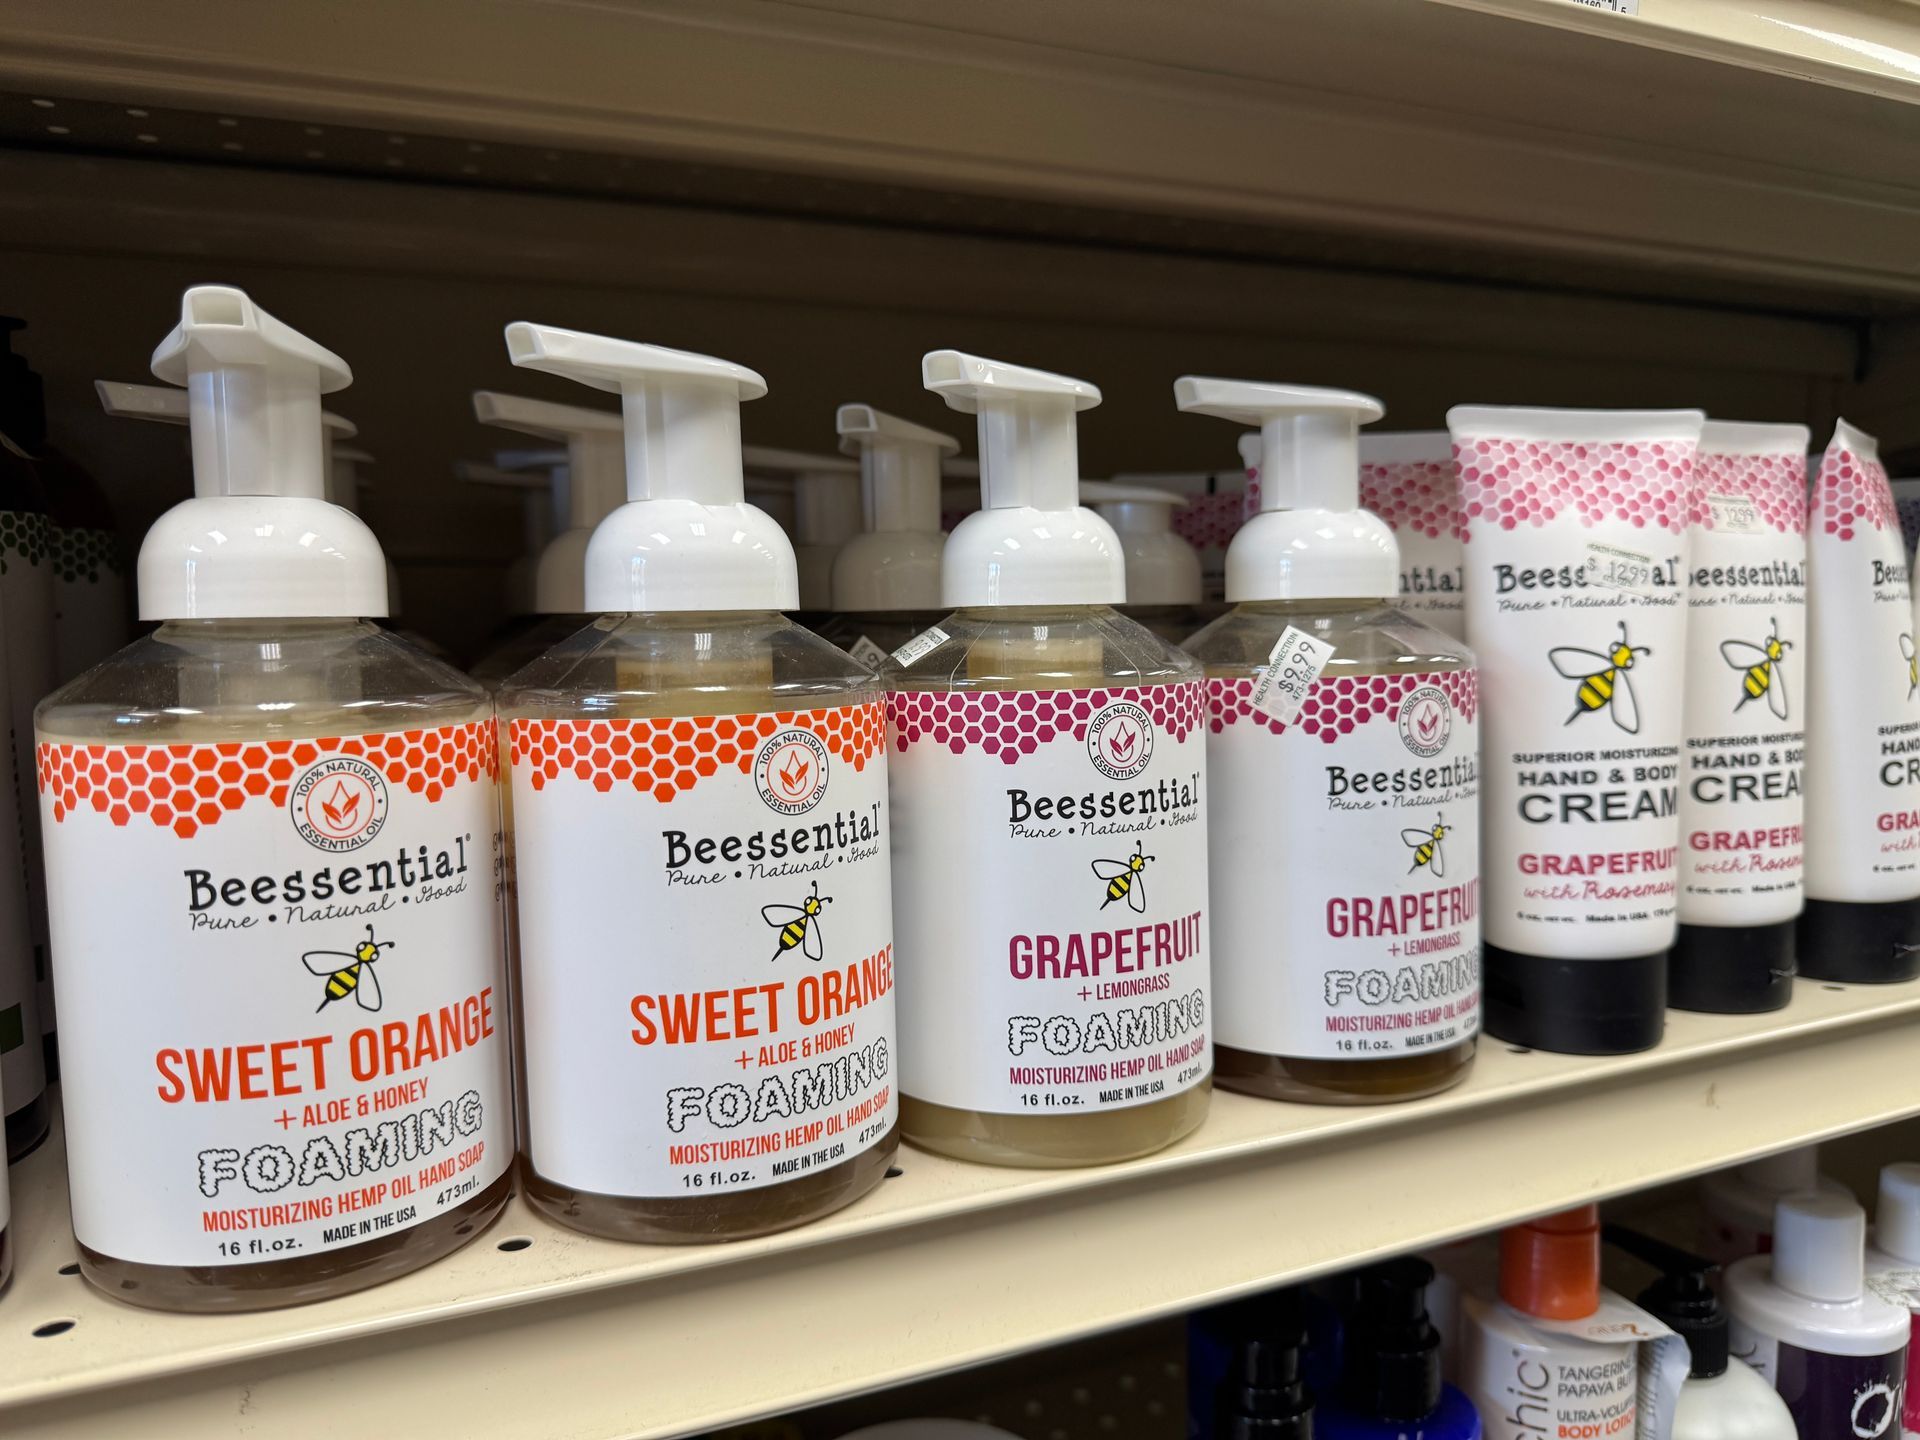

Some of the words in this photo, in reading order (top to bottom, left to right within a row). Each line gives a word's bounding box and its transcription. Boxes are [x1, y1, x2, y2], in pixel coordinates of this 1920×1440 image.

[1254, 672, 1273, 706] HEALTH
[1267, 631, 1299, 680] CONNECTION
[1278, 641, 1317, 693] $9.99
[1292, 664, 1317, 702] 473-1275
[1420, 690, 1448, 711] NATURAL
[1092, 711, 1112, 734] 100%
[1113, 706, 1149, 732] NATURAL
[759, 740, 782, 765] 100%
[783, 733, 824, 761] NATURAL
[1403, 734, 1440, 755] ESSENTIAL
[1440, 732, 1450, 748] OIL
[1512, 752, 1595, 764] SUPERIOR
[1686, 736, 1759, 748] SUPERIOR
[1093, 754, 1139, 778] ESSENTIAL
[1138, 753, 1150, 768] OIL
[1518, 770, 1598, 786] HAND
[1608, 768, 1624, 784] &
[1633, 764, 1677, 782] BODY
[1691, 753, 1761, 769] HAND
[1767, 751, 1780, 765] &
[297, 769, 324, 797] 100%
[326, 761, 381, 791] NATURAL
[761, 788, 814, 813] ESSENTIAL
[812, 783, 826, 801] OIL
[1328, 797, 1375, 811] Pure
[1391, 790, 1453, 808] Natural
[1518, 785, 1677, 824] CREAM
[300, 822, 367, 850] ESSENTIAL
[366, 816, 383, 836] OIL
[1009, 824, 1062, 839] Pure
[1080, 812, 1157, 836] Natural
[666, 869, 726, 887] Pure
[747, 854, 834, 880] Natural
[190, 912, 259, 931] Pure
[284, 894, 396, 925] Natural
[415, 877, 467, 905] Good
[1009, 911, 1202, 980] GRAPEFRUIT
[1404, 931, 1461, 956] LEMONGRASS
[630, 981, 785, 1046] SWEET
[797, 943, 893, 1026] ORANGE
[1096, 973, 1170, 1000] LEMONGRASS
[1008, 988, 1205, 1056] FOAMING
[1326, 1012, 1412, 1032] MOISTURIZING
[1414, 1006, 1442, 1026] HEMP
[1443, 1003, 1455, 1019] OIL
[155, 1034, 333, 1105] SWEET
[349, 987, 495, 1083] ORANGE
[758, 1039, 797, 1068] ALOE
[801, 1036, 812, 1057] &
[815, 1022, 855, 1053] HONEY
[1337, 1040, 1351, 1050] 16
[1405, 1034, 1425, 1047] MADE
[1426, 1033, 1433, 1043] IN
[1434, 1030, 1444, 1042] THE
[1445, 1027, 1455, 1037] USA
[1009, 1064, 1107, 1085] MOISTURIZING
[1110, 1056, 1145, 1080] HEMP
[1147, 1051, 1164, 1072] OIL
[1166, 1043, 1189, 1069] HAND
[1190, 1033, 1205, 1060] SOAP
[666, 1036, 889, 1133] FOAMING
[1021, 1094, 1038, 1106] 16
[1045, 1093, 1084, 1106] fl.oz.
[1099, 1089, 1123, 1103] MADE
[1125, 1087, 1133, 1100] IN
[1134, 1083, 1149, 1098] THE
[1150, 1079, 1164, 1095] USA
[302, 1098, 351, 1128] ALOE
[357, 1093, 369, 1117] &
[373, 1077, 429, 1111] HONEY
[669, 1132, 781, 1166] MOISTURIZING
[785, 1119, 824, 1148] HEMP
[826, 1110, 845, 1136] OIL
[847, 1097, 873, 1129] HAND
[872, 1083, 890, 1113] SOAP
[198, 1089, 484, 1198] FOAMING
[683, 1173, 703, 1188] 16
[710, 1171, 756, 1186] fl.oz.
[772, 1160, 799, 1177] MADE
[801, 1156, 811, 1169] IN
[811, 1148, 829, 1167] THE
[829, 1142, 845, 1161] USA
[858, 1119, 887, 1144] 473ml.
[202, 1196, 333, 1233] MOISTURIZING
[338, 1182, 388, 1214] HEMP
[391, 1171, 417, 1200] OIL
[419, 1156, 457, 1191] HAND
[457, 1140, 485, 1173] SOAP
[218, 1240, 241, 1257] 16
[249, 1236, 303, 1255] fl.oz.
[323, 1225, 358, 1244] MADE
[359, 1222, 372, 1237] IN
[373, 1215, 396, 1235] THE
[396, 1205, 417, 1225] USA
[436, 1174, 481, 1207] 473ml.
[1557, 1381, 1614, 1397] PAPAYA
[1558, 1425, 1600, 1438] BODY
